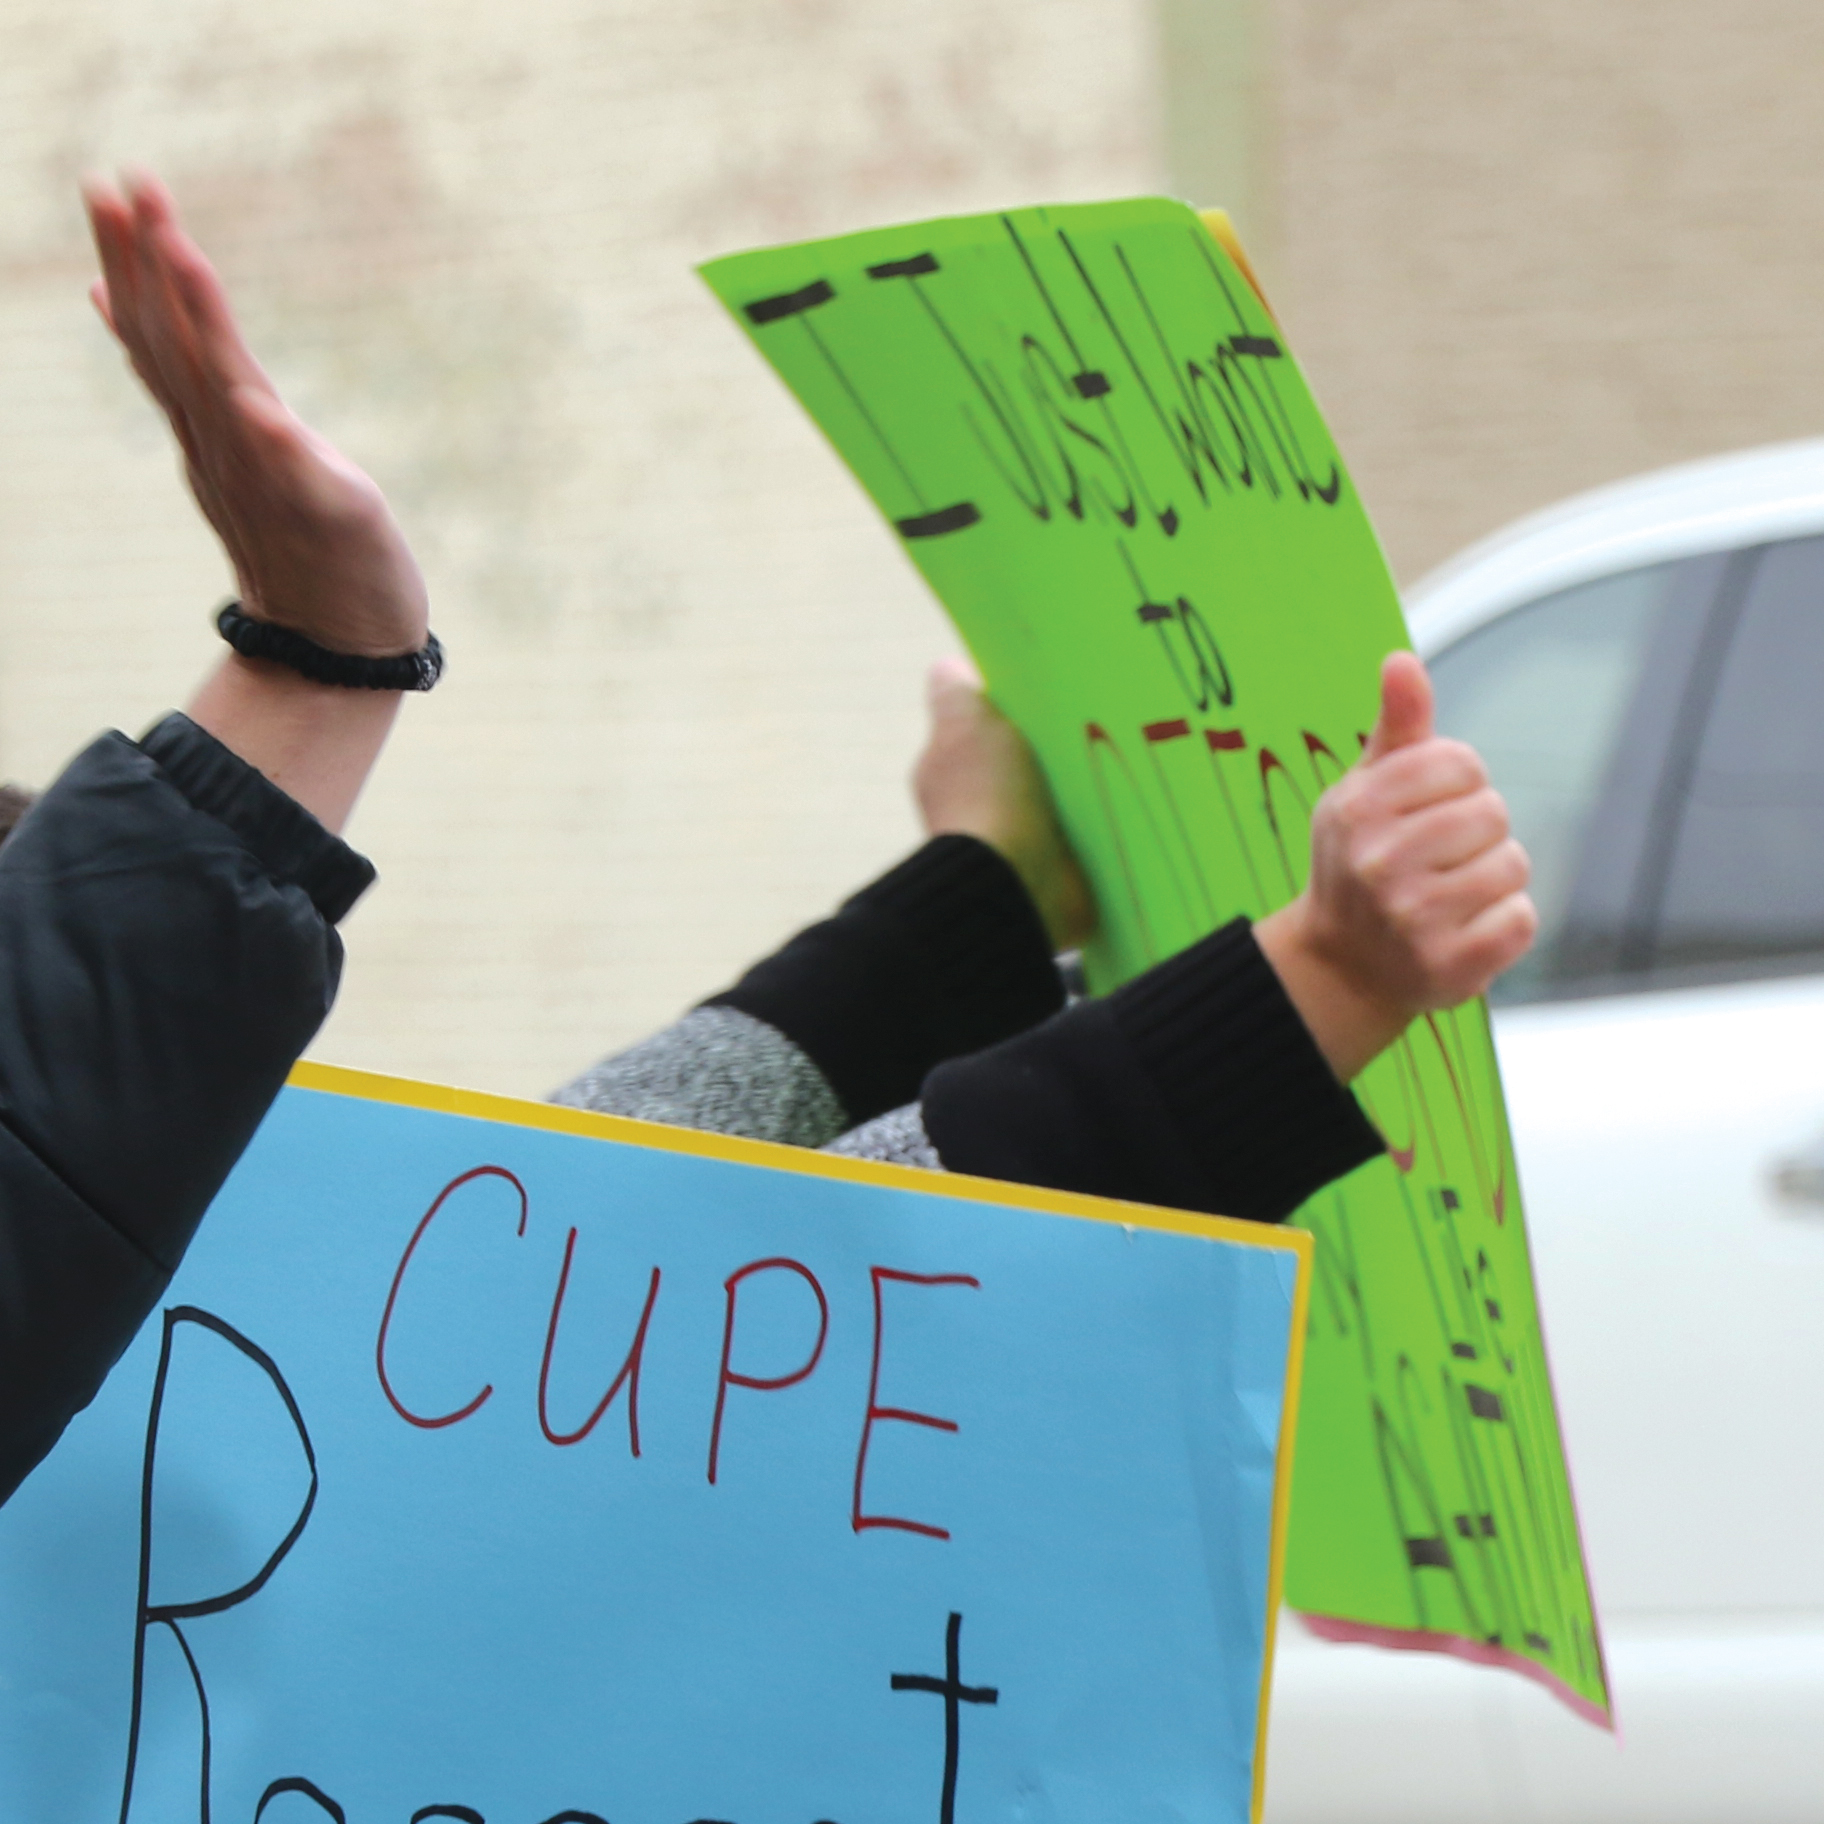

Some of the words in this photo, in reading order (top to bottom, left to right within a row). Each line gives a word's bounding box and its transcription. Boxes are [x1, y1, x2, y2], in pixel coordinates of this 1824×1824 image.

[866, 212, 1179, 538] Just
[1116, 537, 1236, 714] to
[377, 1164, 981, 1542] CUPE
